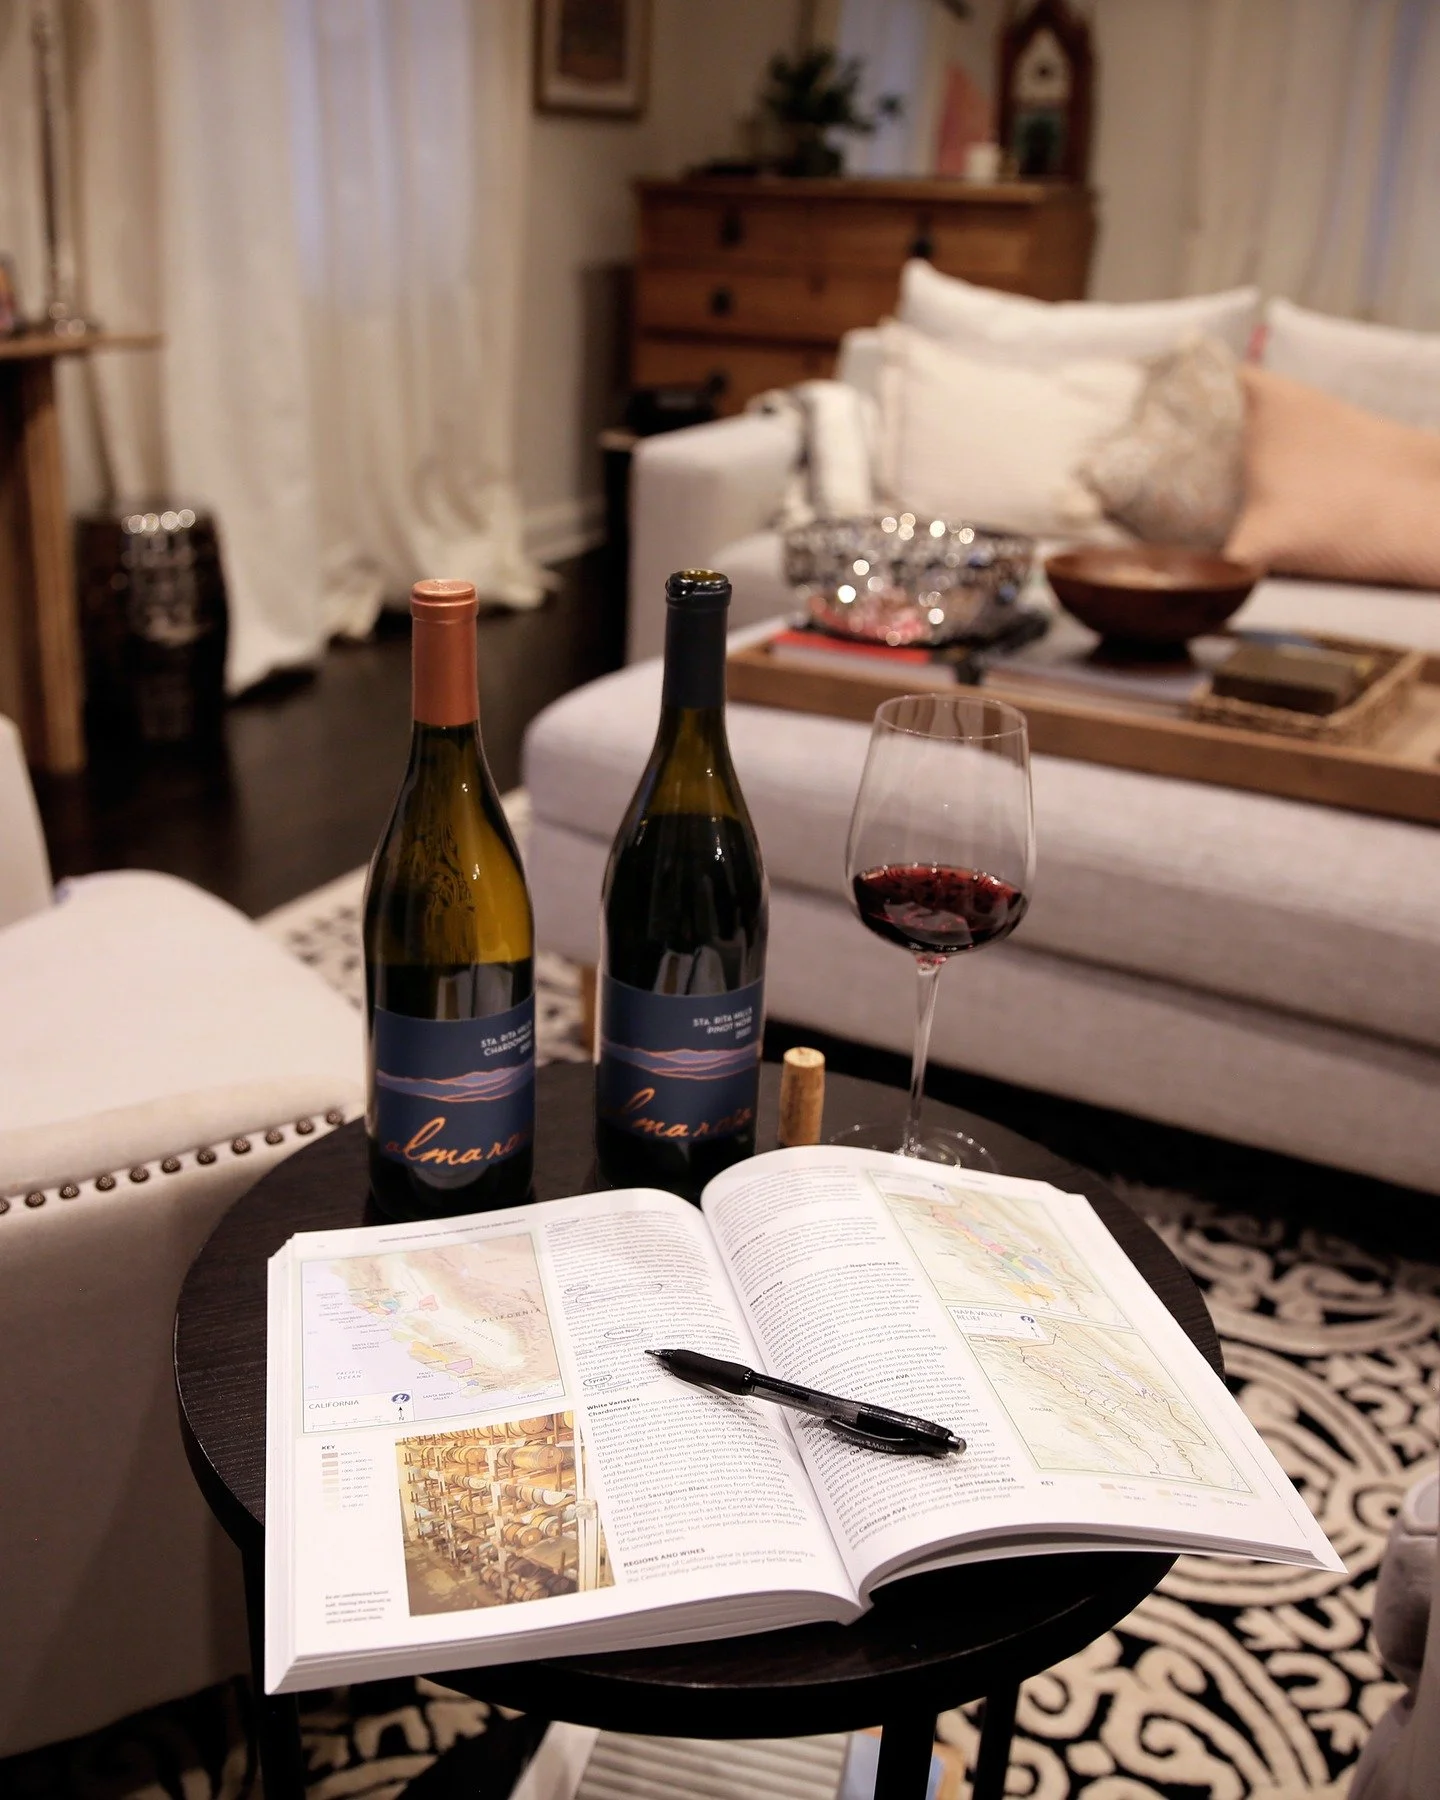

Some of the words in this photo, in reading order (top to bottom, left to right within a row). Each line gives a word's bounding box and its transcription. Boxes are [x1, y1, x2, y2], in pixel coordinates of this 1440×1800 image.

[713, 1014, 733, 1025] RITA
[707, 1022, 733, 1034] PINOT
[501, 1030, 517, 1042] RITA
[474, 1308, 541, 1324] CALIFORNIA
[851, 1383, 863, 1392] Los
[864, 1375, 895, 1388] Carneros
[308, 1400, 360, 1410] CALIFORNIA
[586, 1401, 608, 1410] White
[608, 1395, 640, 1406] Varieties
[588, 1404, 631, 1418] Chardonnay
[859, 1511, 892, 1534] Calistoga
[892, 1505, 908, 1516] AVA
[623, 1555, 659, 1568] REGIONS
[660, 1552, 678, 1560] AND
[679, 1548, 706, 1556] WINES
